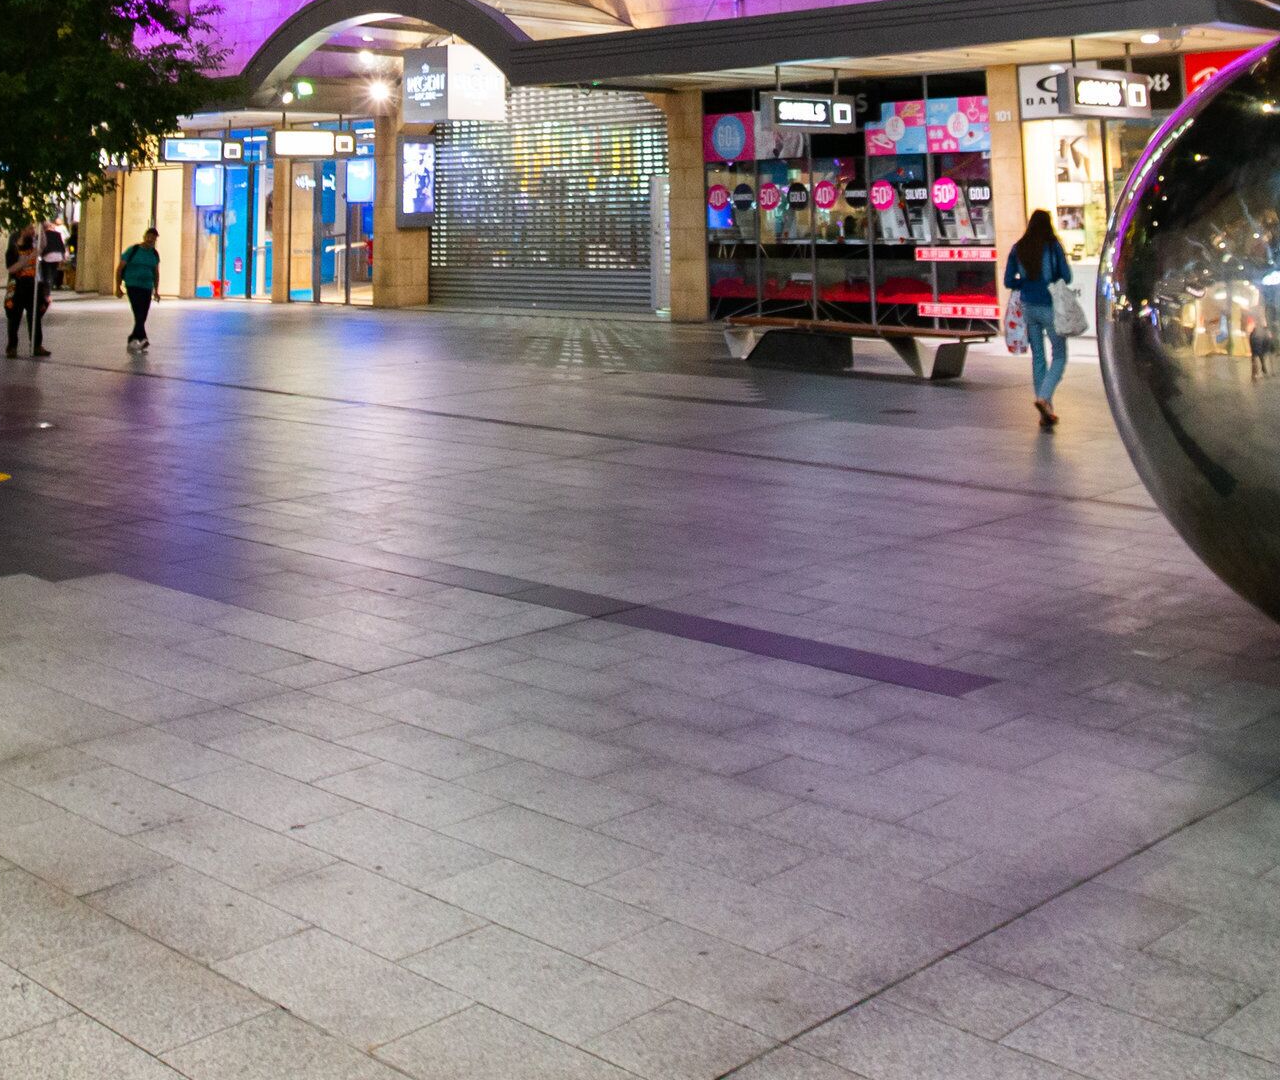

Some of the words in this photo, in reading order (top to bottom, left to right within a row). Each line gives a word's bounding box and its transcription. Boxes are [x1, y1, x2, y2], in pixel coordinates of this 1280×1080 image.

[995, 110, 1011, 122] 101
[789, 191, 807, 203] GOLD
[904, 188, 928, 200] SILVER
[969, 186, 991, 201] GOLD
